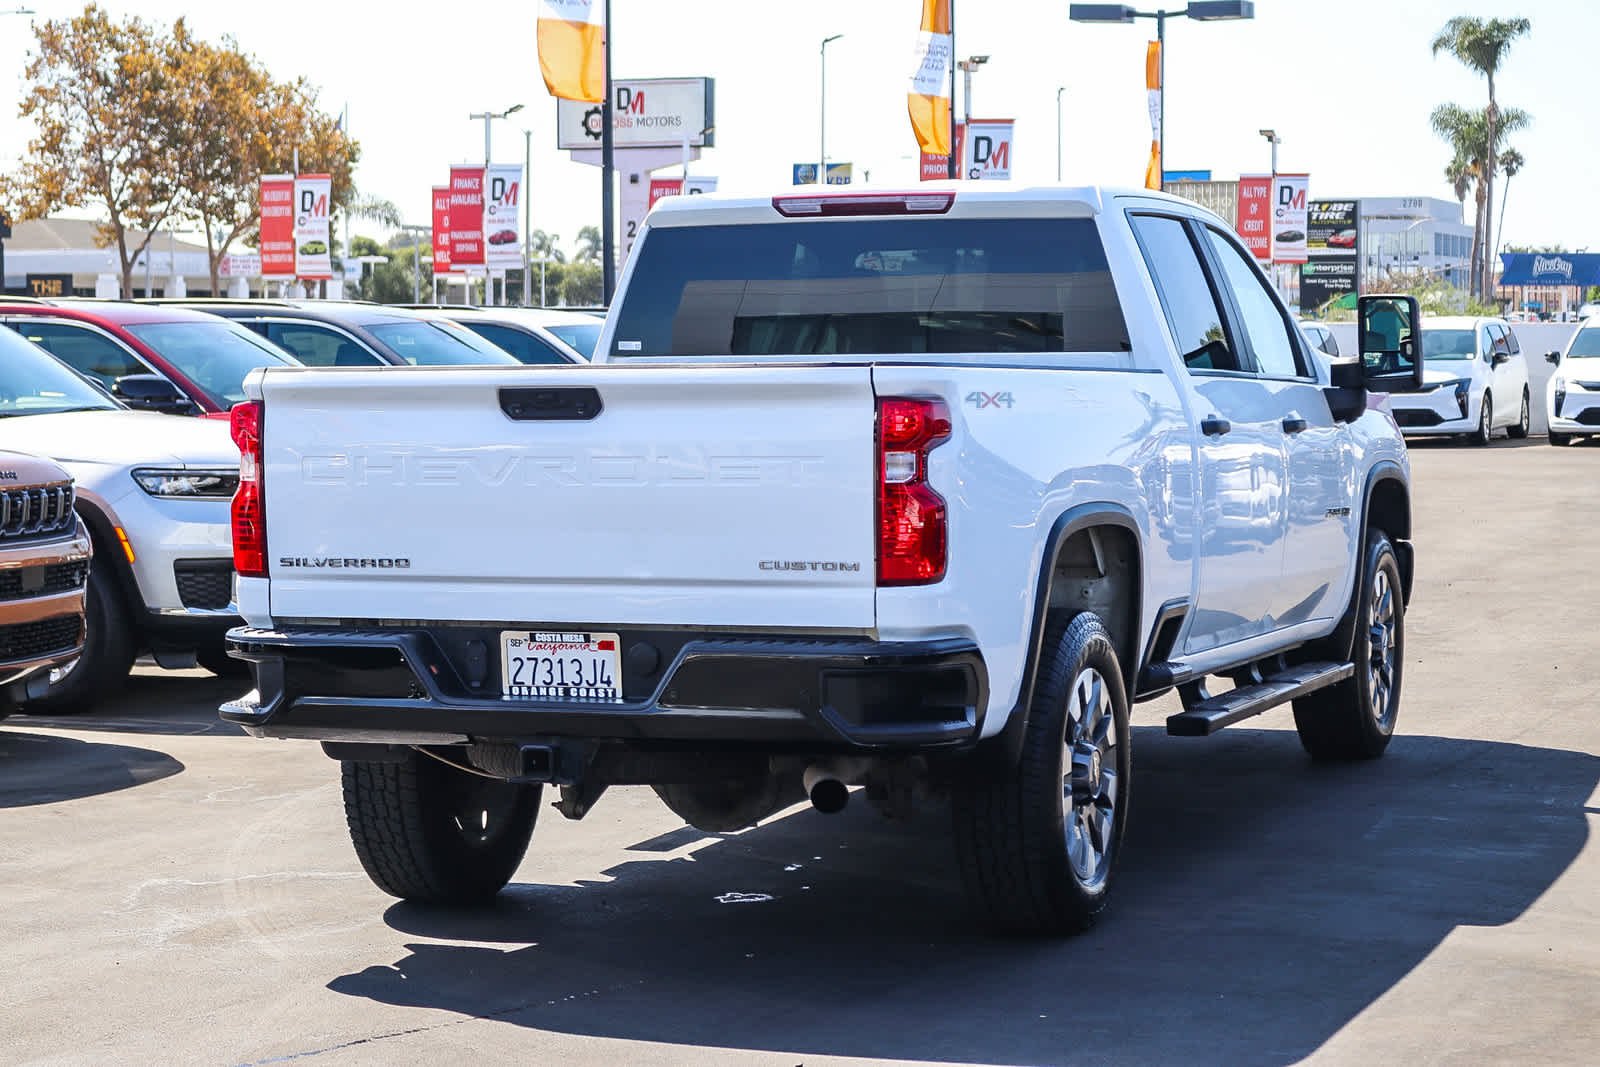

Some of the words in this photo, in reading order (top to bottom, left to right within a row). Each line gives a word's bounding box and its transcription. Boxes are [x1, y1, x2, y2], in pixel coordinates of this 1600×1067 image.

[637, 115, 682, 128] MOTORS
[454, 177, 481, 190] FINANCE
[1311, 212, 1346, 220] TIRE
[302, 455, 824, 487] CHEVROLET
[279, 557, 411, 569] SILVERADO
[758, 560, 860, 572] CUSTOM
[510, 638, 523, 648] SEP
[535, 633, 562, 643] COSTA
[562, 634, 585, 644] MESA
[512, 657, 613, 688] 27313J4
[512, 686, 565, 697] ORANGE
[569, 687, 614, 698] COAST
